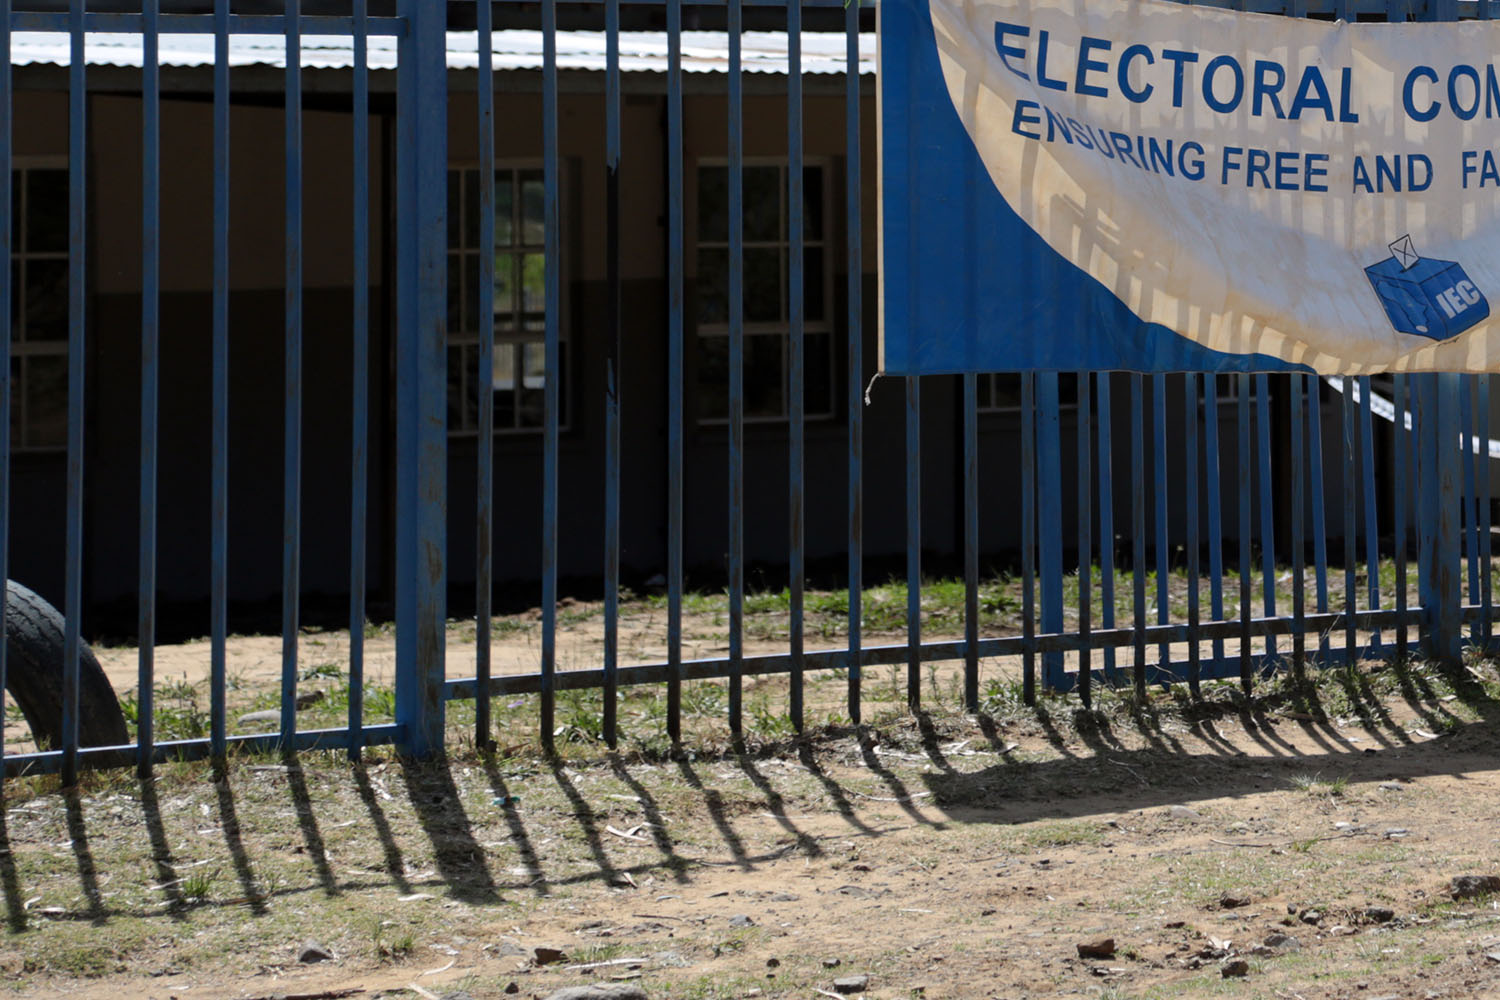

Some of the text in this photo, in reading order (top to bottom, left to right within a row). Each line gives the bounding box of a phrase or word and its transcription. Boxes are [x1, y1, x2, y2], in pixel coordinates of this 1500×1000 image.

[994, 22, 1359, 123] ELECTORAL
[1012, 99, 1206, 181] ENSURING
[1223, 147, 1329, 192] FREE
[1354, 154, 1433, 194] AND
[1435, 279, 1481, 319] IEC
